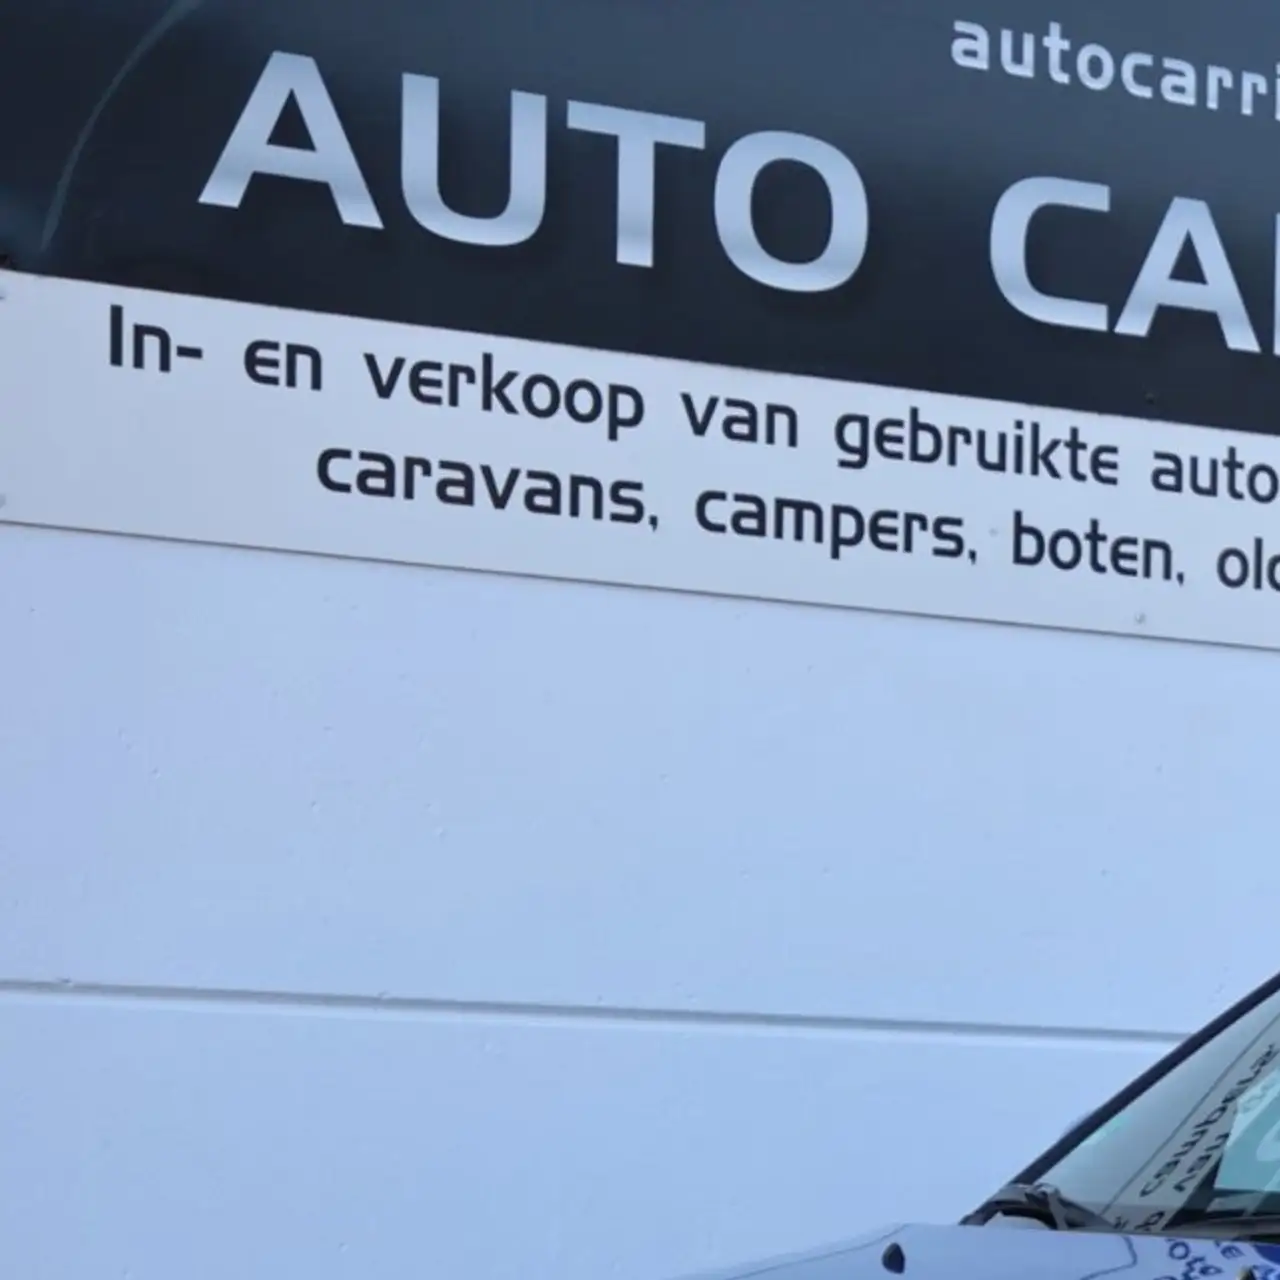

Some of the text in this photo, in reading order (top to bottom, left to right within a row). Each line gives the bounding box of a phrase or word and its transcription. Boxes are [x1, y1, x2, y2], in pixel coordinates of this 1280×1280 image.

[198, 51, 869, 293] AUTO
[108, 304, 203, 374] In-
[243, 338, 323, 391] en
[362, 352, 645, 442] verkoop
[680, 391, 798, 448] van
[833, 405, 1119, 486] gebruikte
[316, 446, 658, 531] caravans,
[694, 489, 977, 564] campers,
[1012, 509, 1185, 586] boten,
